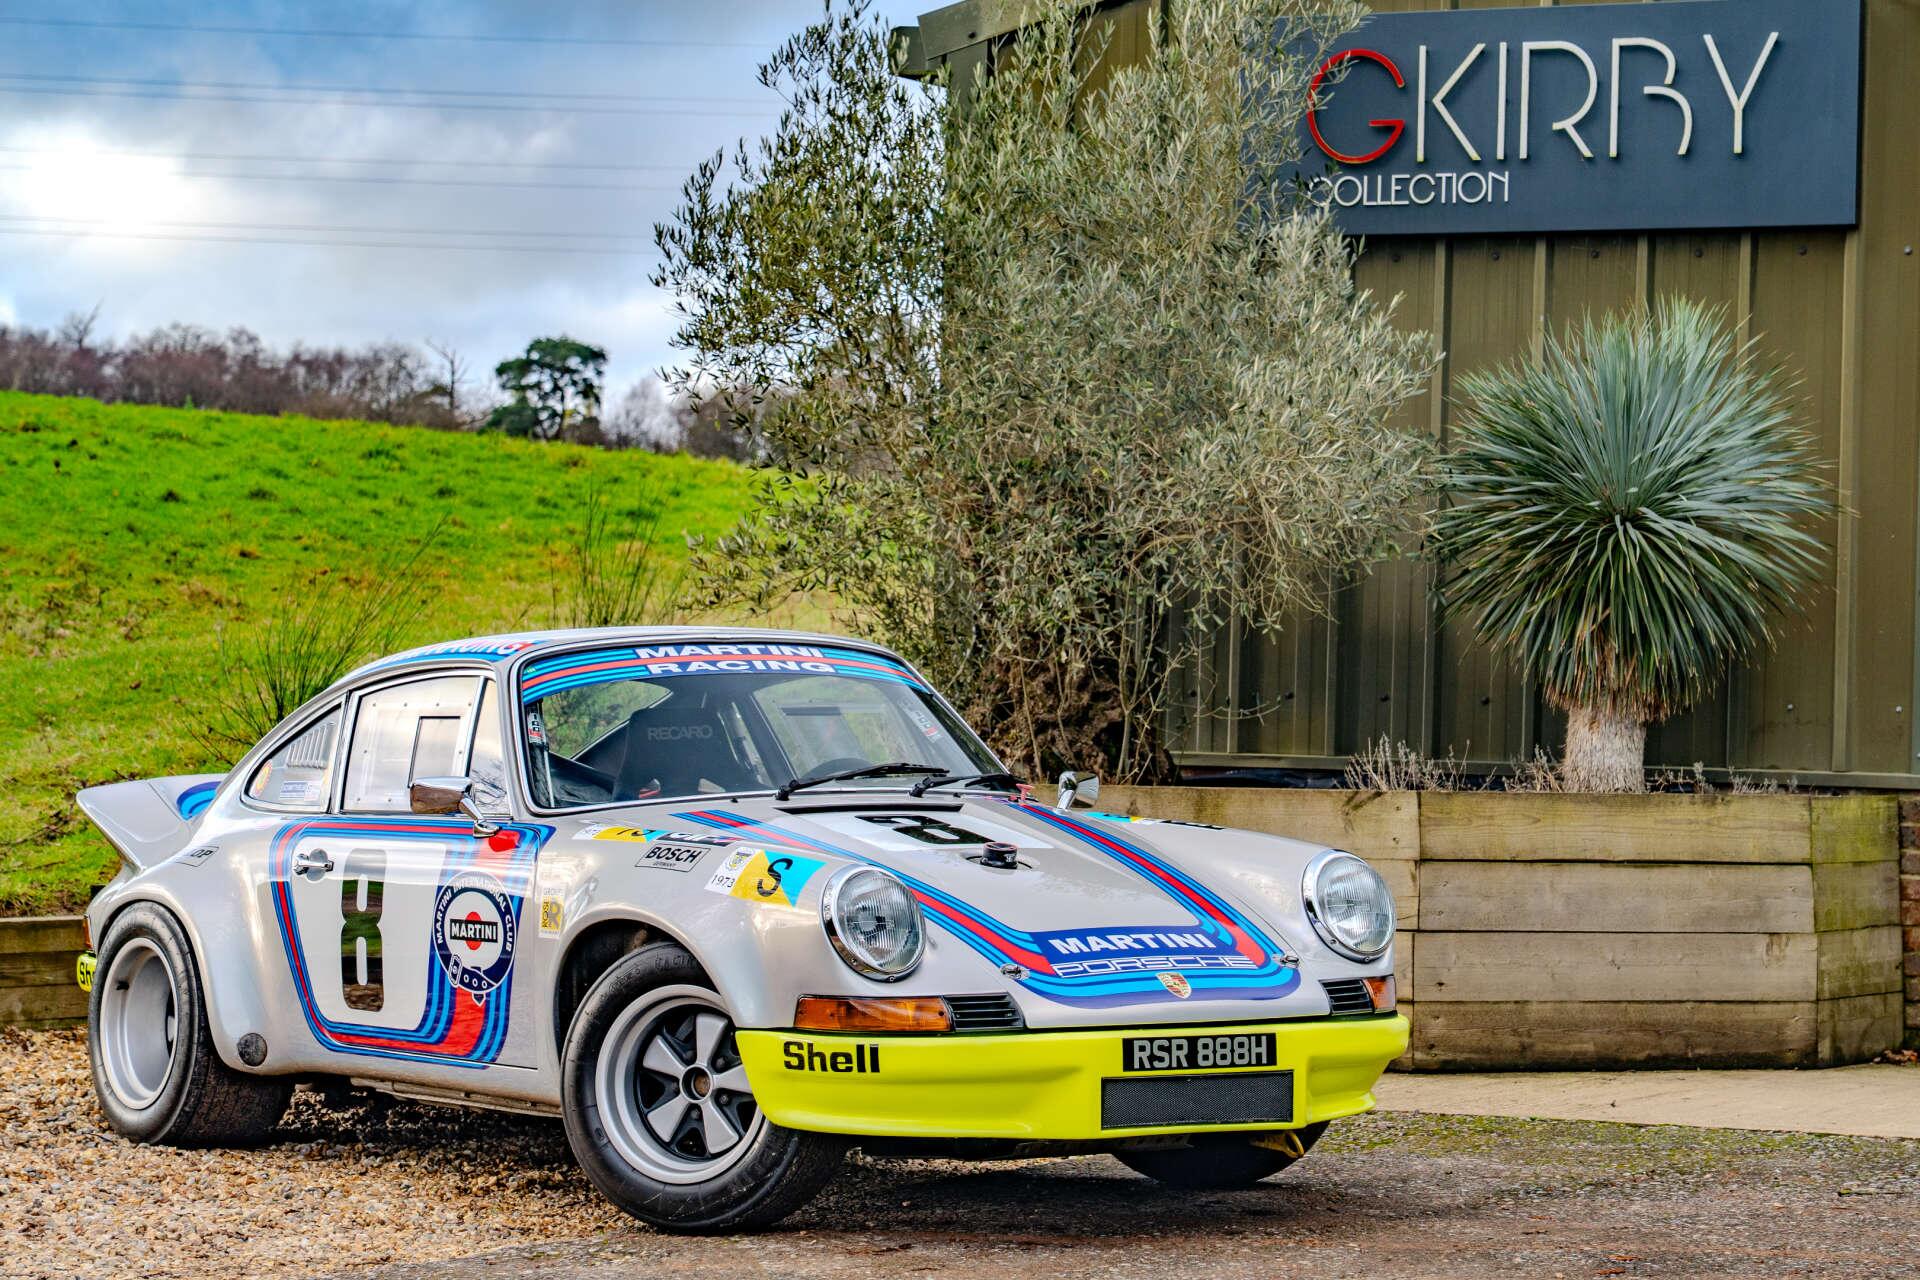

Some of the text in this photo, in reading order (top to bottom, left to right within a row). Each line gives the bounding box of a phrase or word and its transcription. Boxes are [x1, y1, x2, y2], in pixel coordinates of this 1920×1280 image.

[634, 644, 825, 659] MARTINI
[647, 660, 836, 674] RACING
[648, 724, 713, 741] RECARO
[645, 846, 702, 863] BOSCH
[711, 874, 736, 889] 1973
[756, 857, 794, 898] S
[341, 848, 385, 1012] 8
[436, 888, 453, 945] MARTINI
[505, 914, 514, 953] CLUB
[451, 922, 498, 941] MARTINI
[1048, 933, 1217, 955] MARTINI
[1050, 955, 1258, 979] PORSCHE
[783, 1040, 881, 1073] Shell
[1133, 1035, 1268, 1070] RSR 888H
